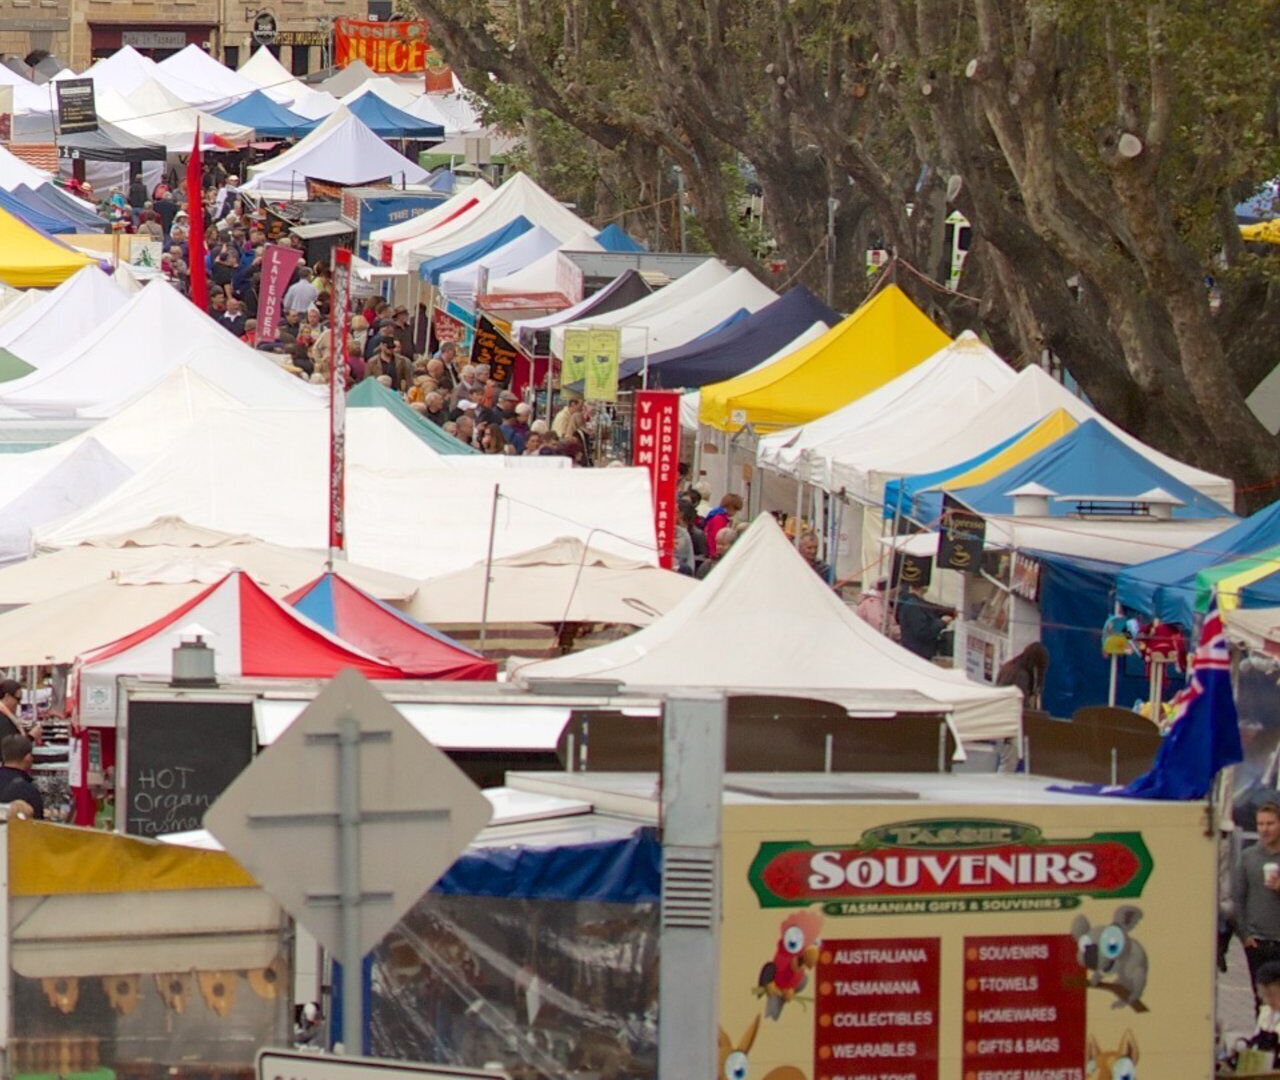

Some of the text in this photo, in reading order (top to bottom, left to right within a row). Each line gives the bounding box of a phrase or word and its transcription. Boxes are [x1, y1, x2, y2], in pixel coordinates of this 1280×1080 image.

[344, 39, 424, 72] JUICE
[262, 251, 280, 336] LAVENDER
[640, 401, 653, 464] YUMM
[659, 406, 672, 558] HANDMADE TREATS
[138, 766, 195, 789] HOT
[134, 792, 208, 820] Organ
[129, 817, 198, 836] Tasma
[893, 827, 1010, 846] TASSIE
[808, 851, 1096, 890] SOUVENIRS
[841, 898, 1062, 915] TASMANIAN GIFTS & SOUVENIRS
[834, 949, 927, 964] AUSTRALIANA
[979, 945, 1049, 961] SOUVENIRS
[834, 981, 920, 996] TASMANIANA
[979, 976, 1038, 991] T-TOWELS
[834, 1012, 932, 1027] COLLECTIBLES
[978, 1008, 1057, 1022] HOMEWARES
[833, 1043, 916, 1058] WEARABLES
[978, 1038, 1060, 1054] GIFTS & BAGS
